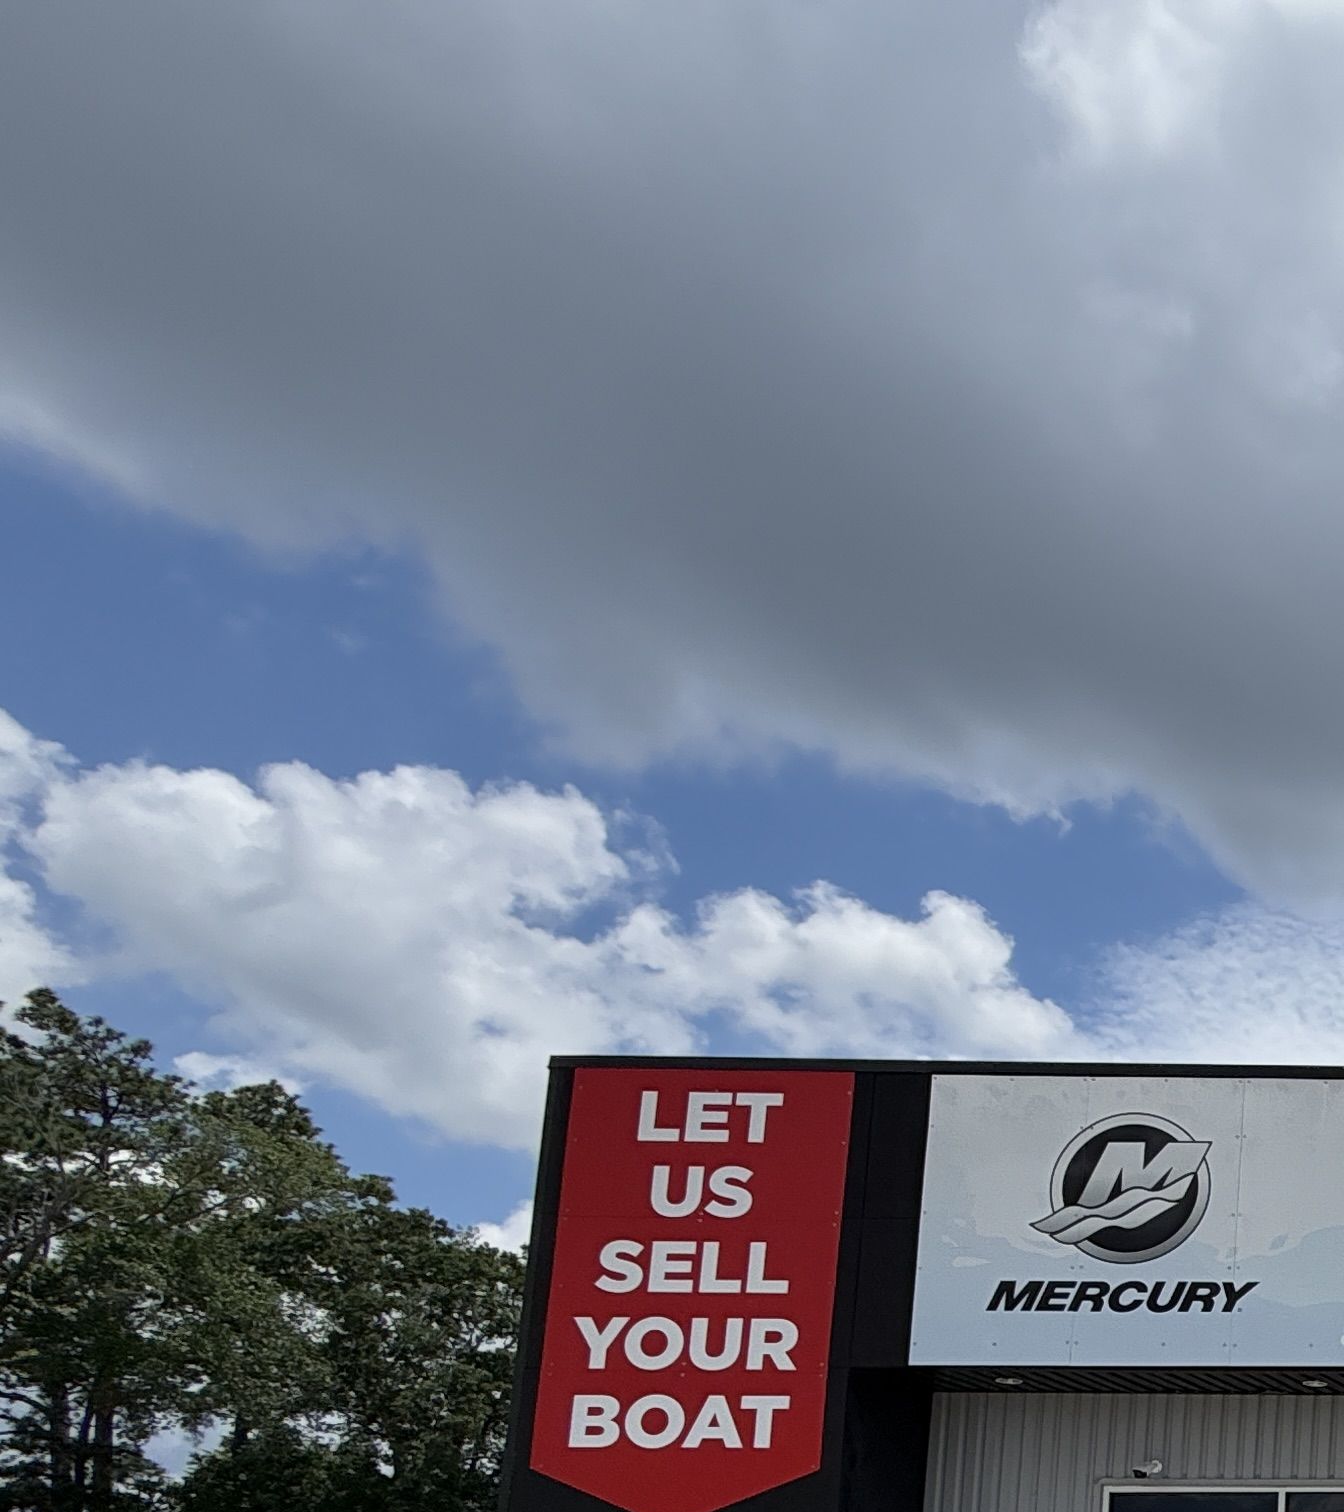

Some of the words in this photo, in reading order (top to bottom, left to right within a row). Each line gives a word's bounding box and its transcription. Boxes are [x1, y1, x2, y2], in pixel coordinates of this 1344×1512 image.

[636, 1090, 785, 1143] LET
[650, 1165, 754, 1219] US
[594, 1239, 789, 1294] SELL
[985, 1279, 1260, 1314] MERCURY
[573, 1316, 800, 1371] YOUR
[567, 1394, 791, 1449] BOAT
